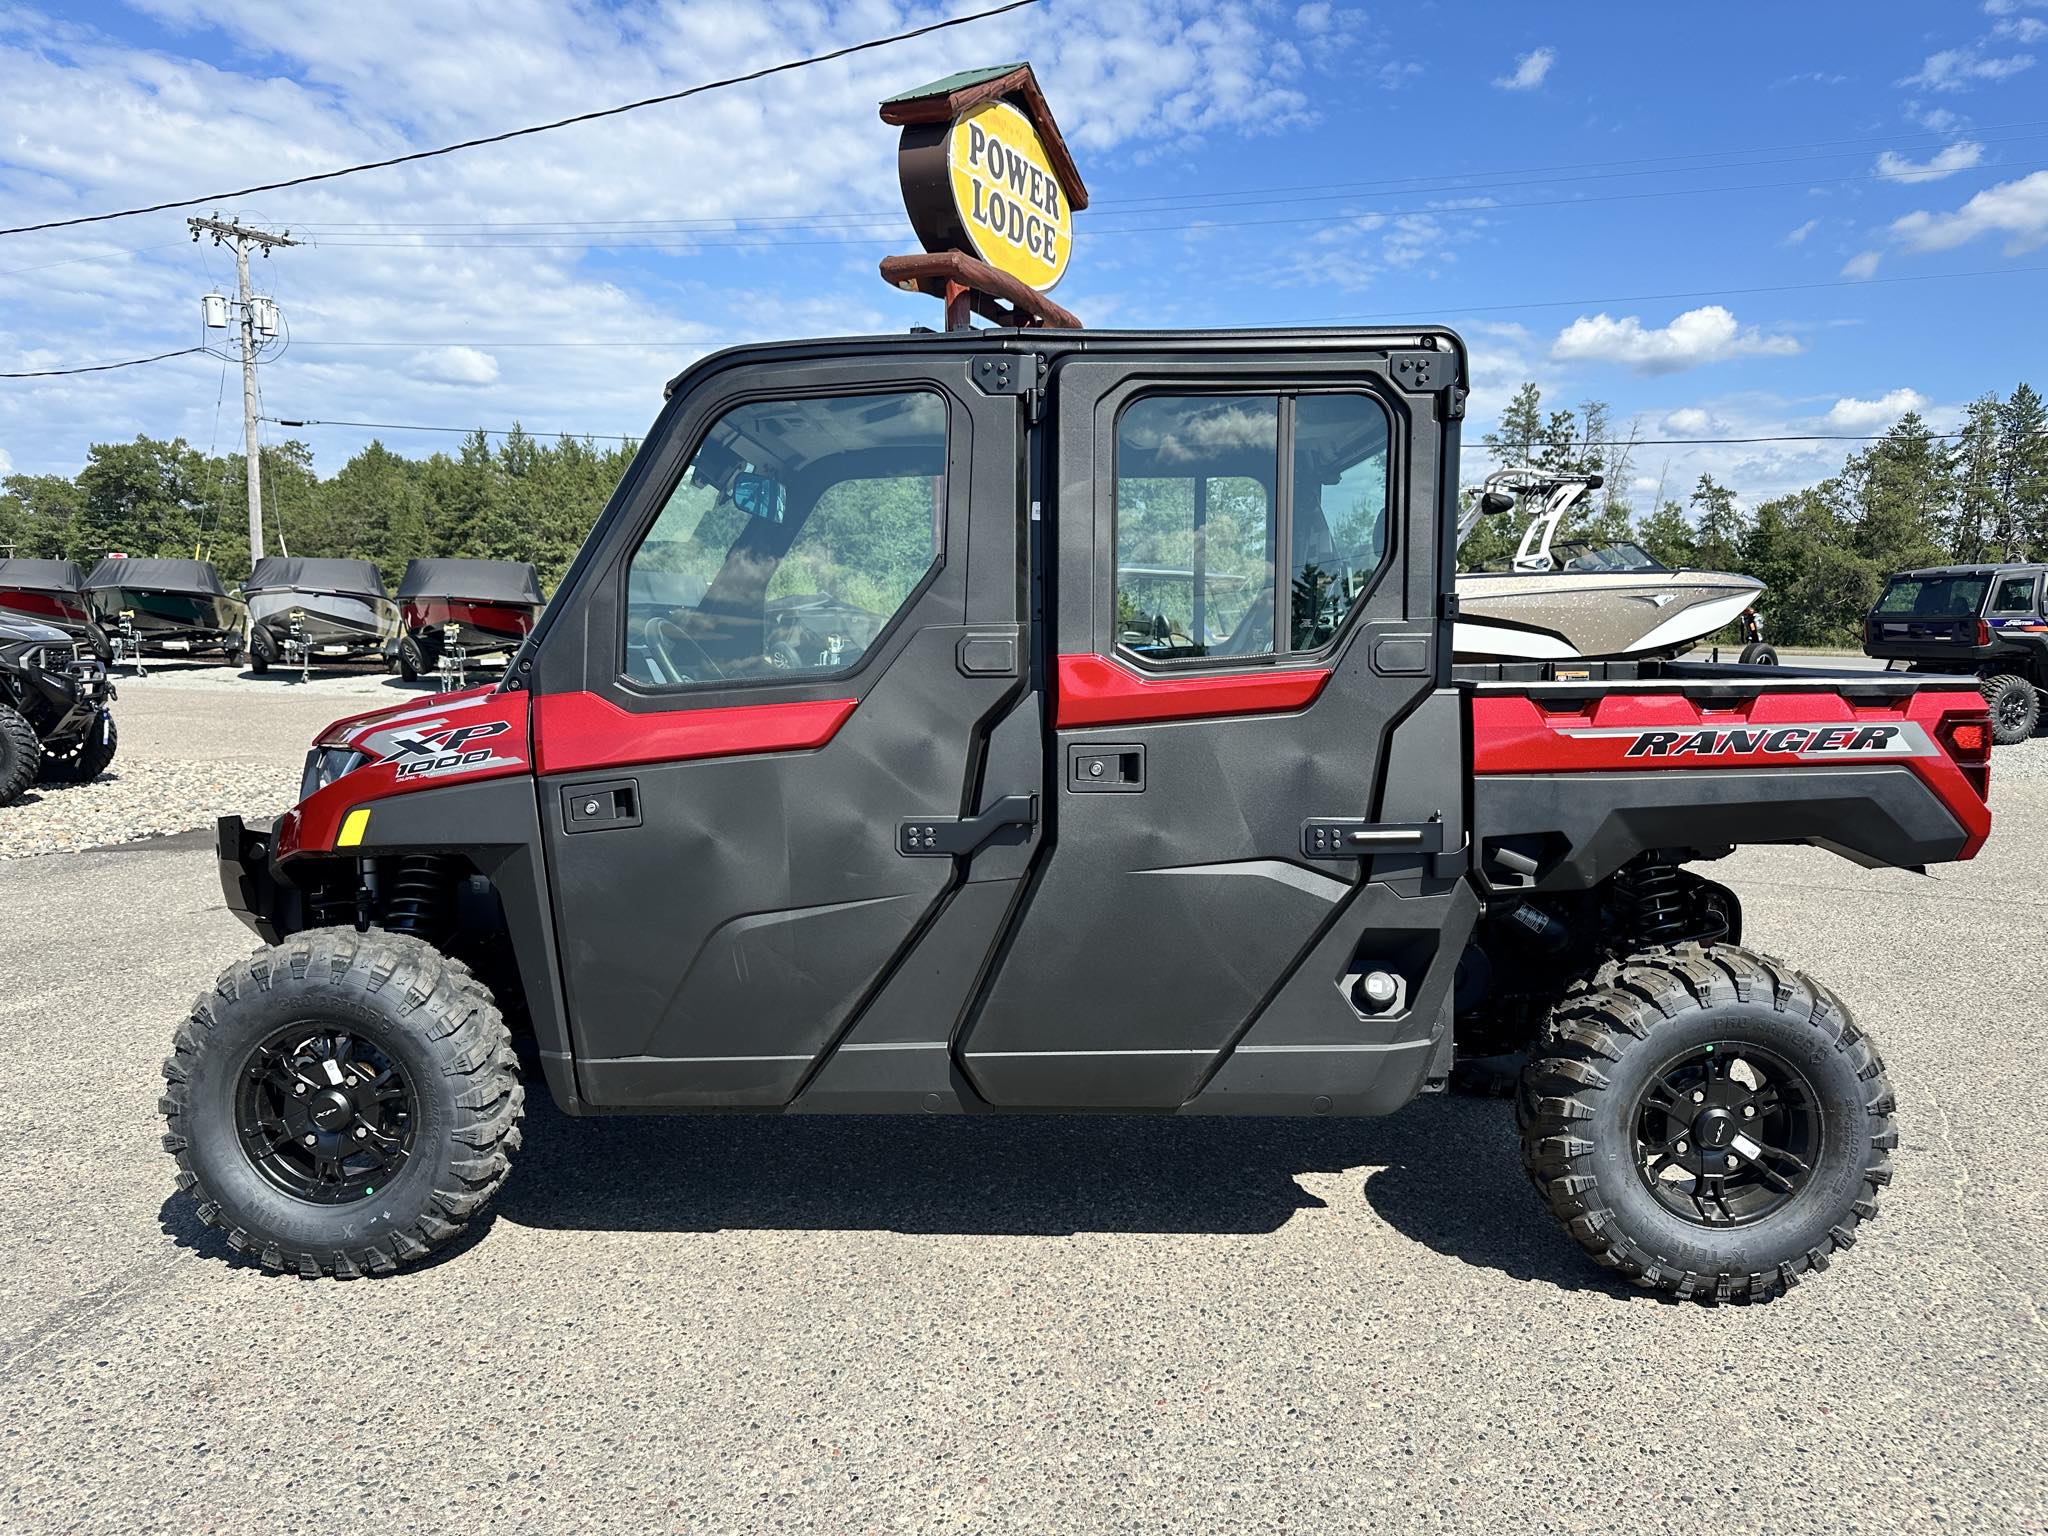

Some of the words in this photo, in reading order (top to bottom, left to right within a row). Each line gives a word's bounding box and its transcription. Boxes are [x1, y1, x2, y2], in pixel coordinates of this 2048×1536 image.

[969, 123, 1060, 220] POWER
[972, 178, 1056, 265] LODGE
[370, 720, 512, 767] XP
[396, 749, 492, 778] 1000
[1625, 726, 1901, 758] RANGER
